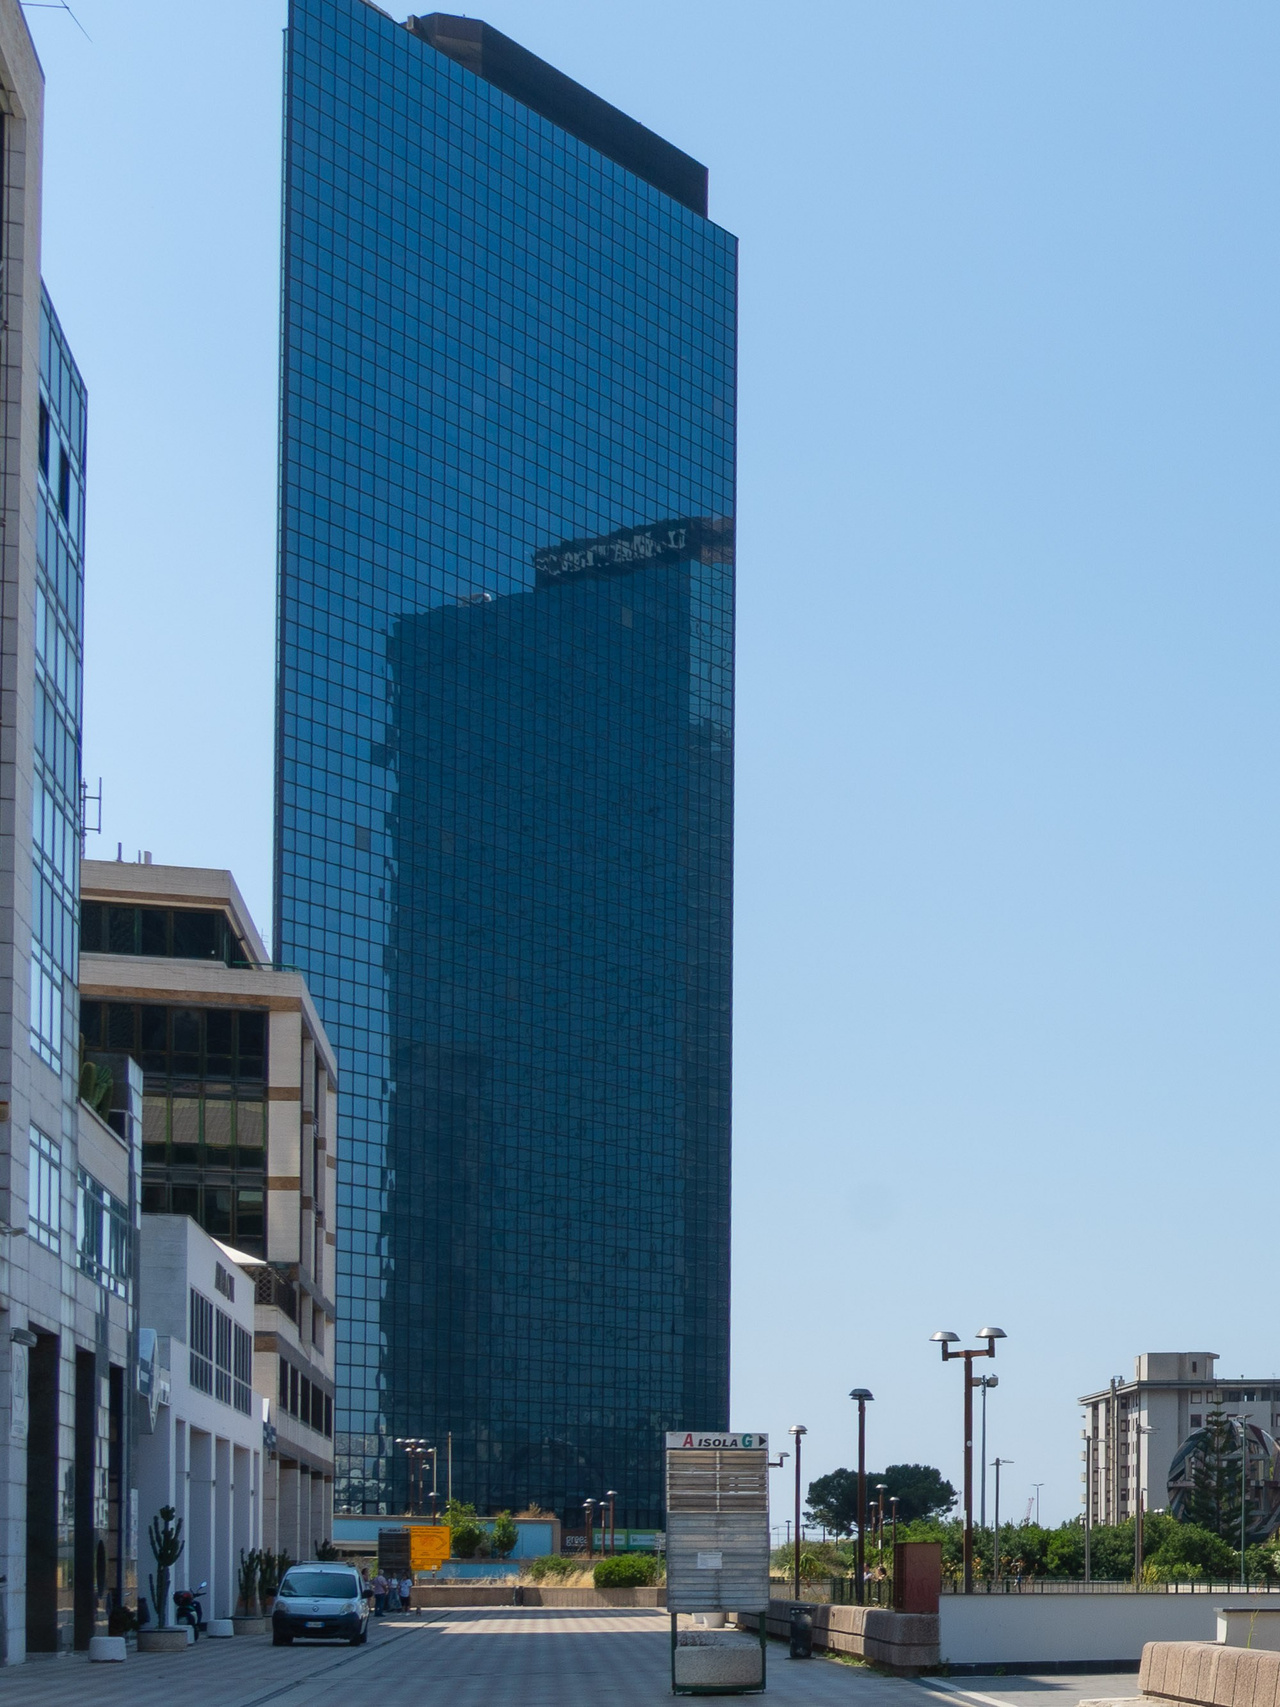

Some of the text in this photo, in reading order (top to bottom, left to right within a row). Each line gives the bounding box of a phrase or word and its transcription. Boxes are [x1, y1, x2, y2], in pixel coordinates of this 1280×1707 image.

[683, 1433, 753, 1448] A ISOLA G
